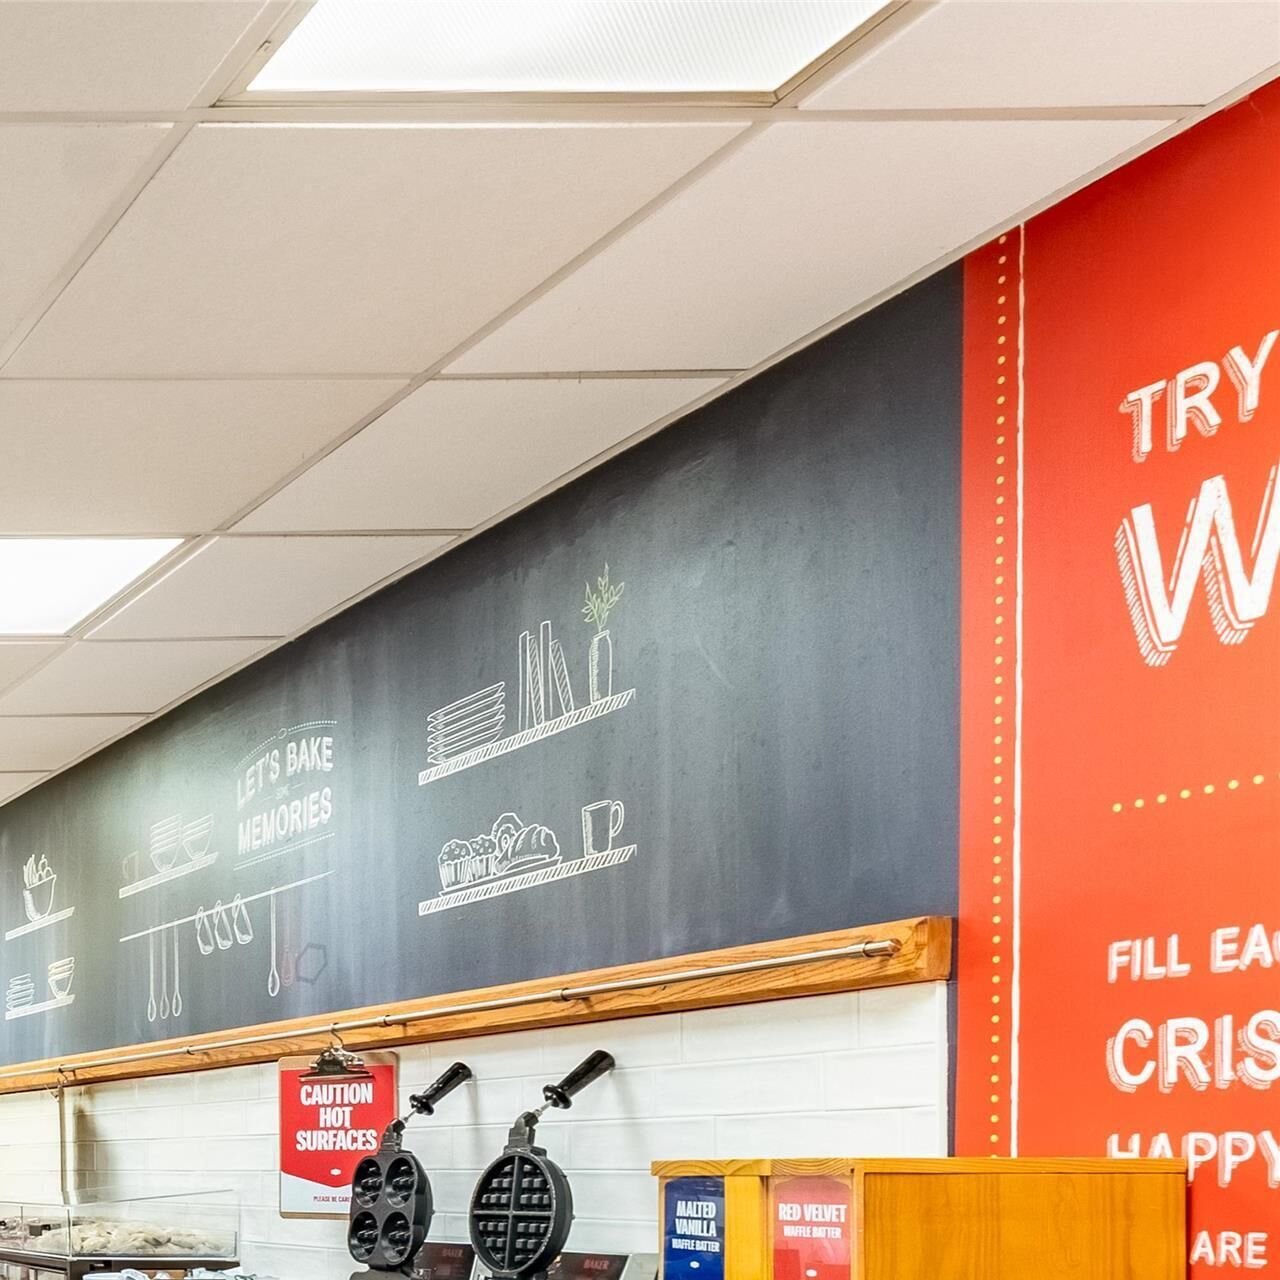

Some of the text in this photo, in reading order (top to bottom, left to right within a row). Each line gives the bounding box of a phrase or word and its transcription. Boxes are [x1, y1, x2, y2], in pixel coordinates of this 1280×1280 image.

[1119, 329, 1280, 463] TRY
[238, 736, 334, 811] LET'S BAKE
[238, 787, 332, 856] MEMORIES
[1108, 933, 1191, 984] FILL
[300, 1083, 373, 1106] CAUTION
[319, 1106, 354, 1128] HOT
[295, 1129, 378, 1151] SURFACES
[313, 1195, 331, 1203] PLEASE
[331, 1195, 338, 1203] BE
[676, 1200, 716, 1218] MALTED
[778, 1203, 848, 1223] RED VELVET
[675, 1218, 717, 1237] VANILLA
[783, 1225, 842, 1239] WAFFLE BATTER
[672, 1238, 720, 1252] WAFFLE BATTER
[1189, 1229, 1268, 1270] ARE
